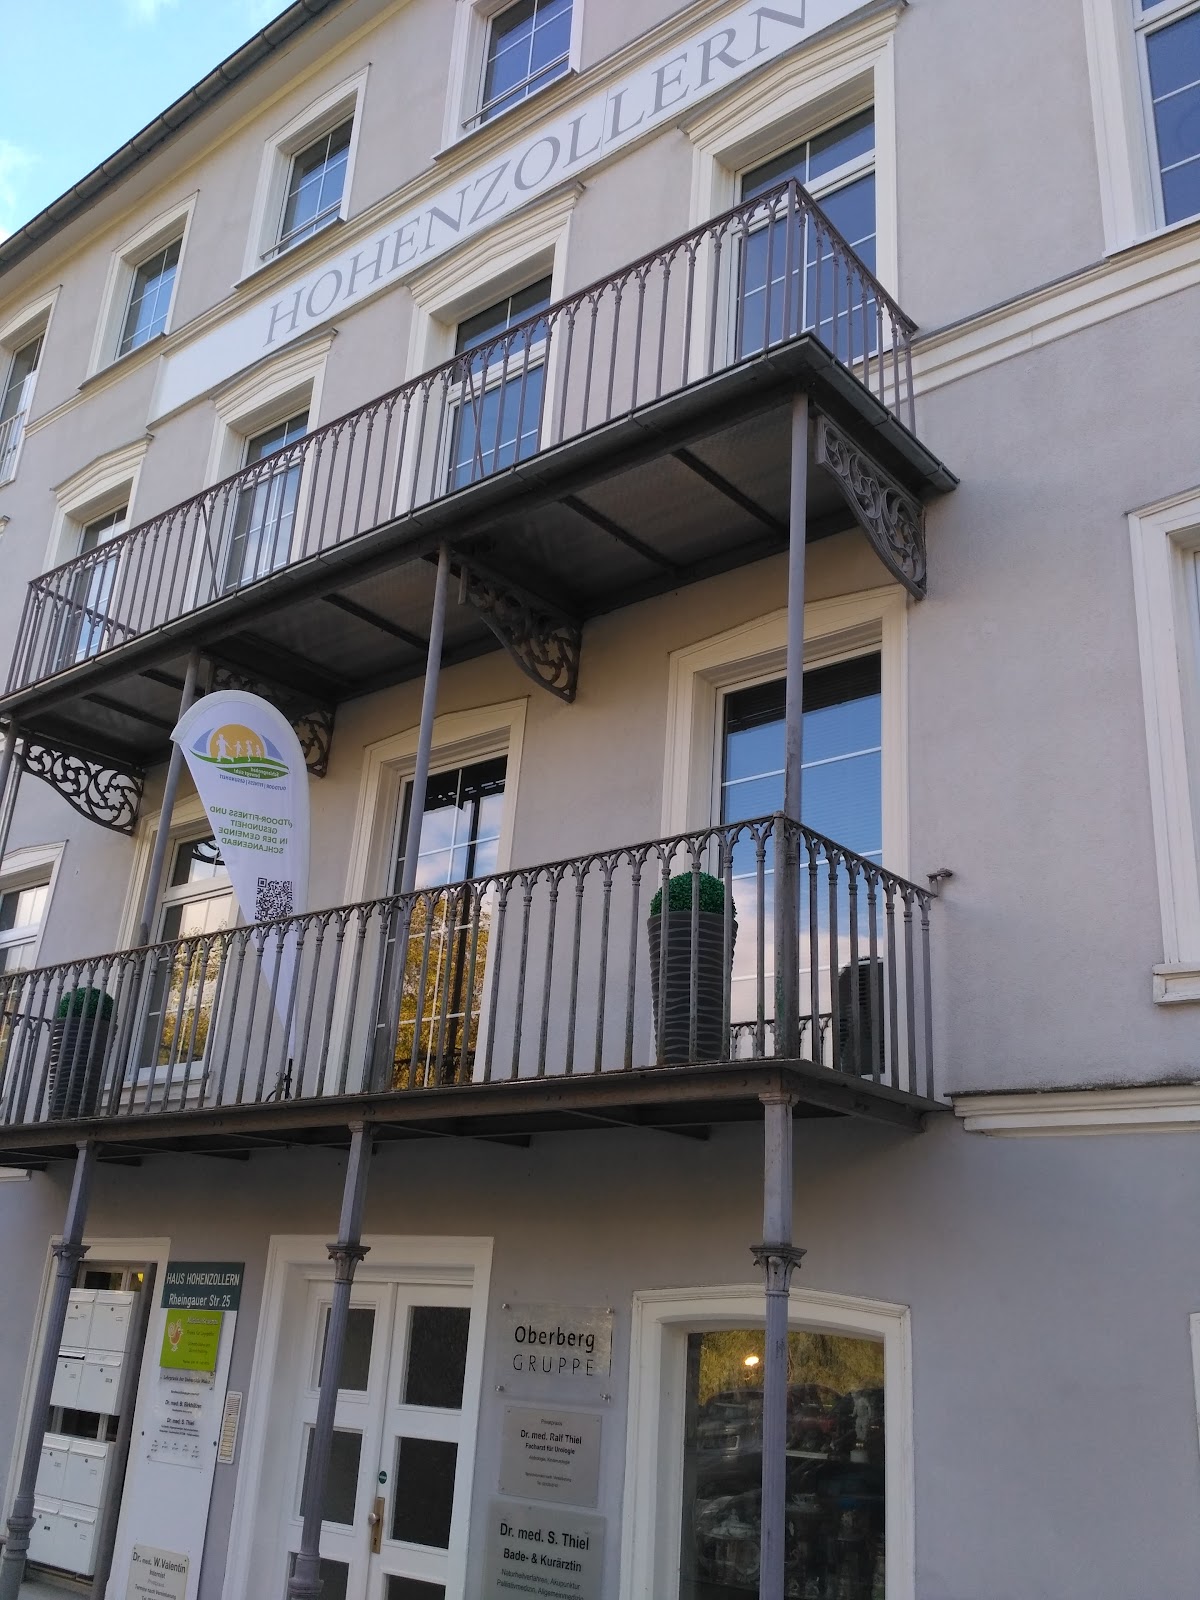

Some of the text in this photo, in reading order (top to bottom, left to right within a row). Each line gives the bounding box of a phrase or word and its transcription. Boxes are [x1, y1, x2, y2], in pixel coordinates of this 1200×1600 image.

[264, 0, 807, 347] HOHENZOLLERN
[166, 1272, 240, 1286] HAUS HOHENZOLLERN
[168, 1293, 207, 1308] Rheingauer
[515, 1325, 595, 1353] Oberberg
[513, 1354, 594, 1376] GRUPPE
[520, 1429, 582, 1444] Dr. med. Ralf Thiel
[525, 1442, 575, 1455] Facharzt für Urologie
[500, 1523, 589, 1550] Dr. med. S. Thiel
[132, 1552, 142, 1563] Dr.
[503, 1548, 582, 1572] Bade- & Kurärztin
